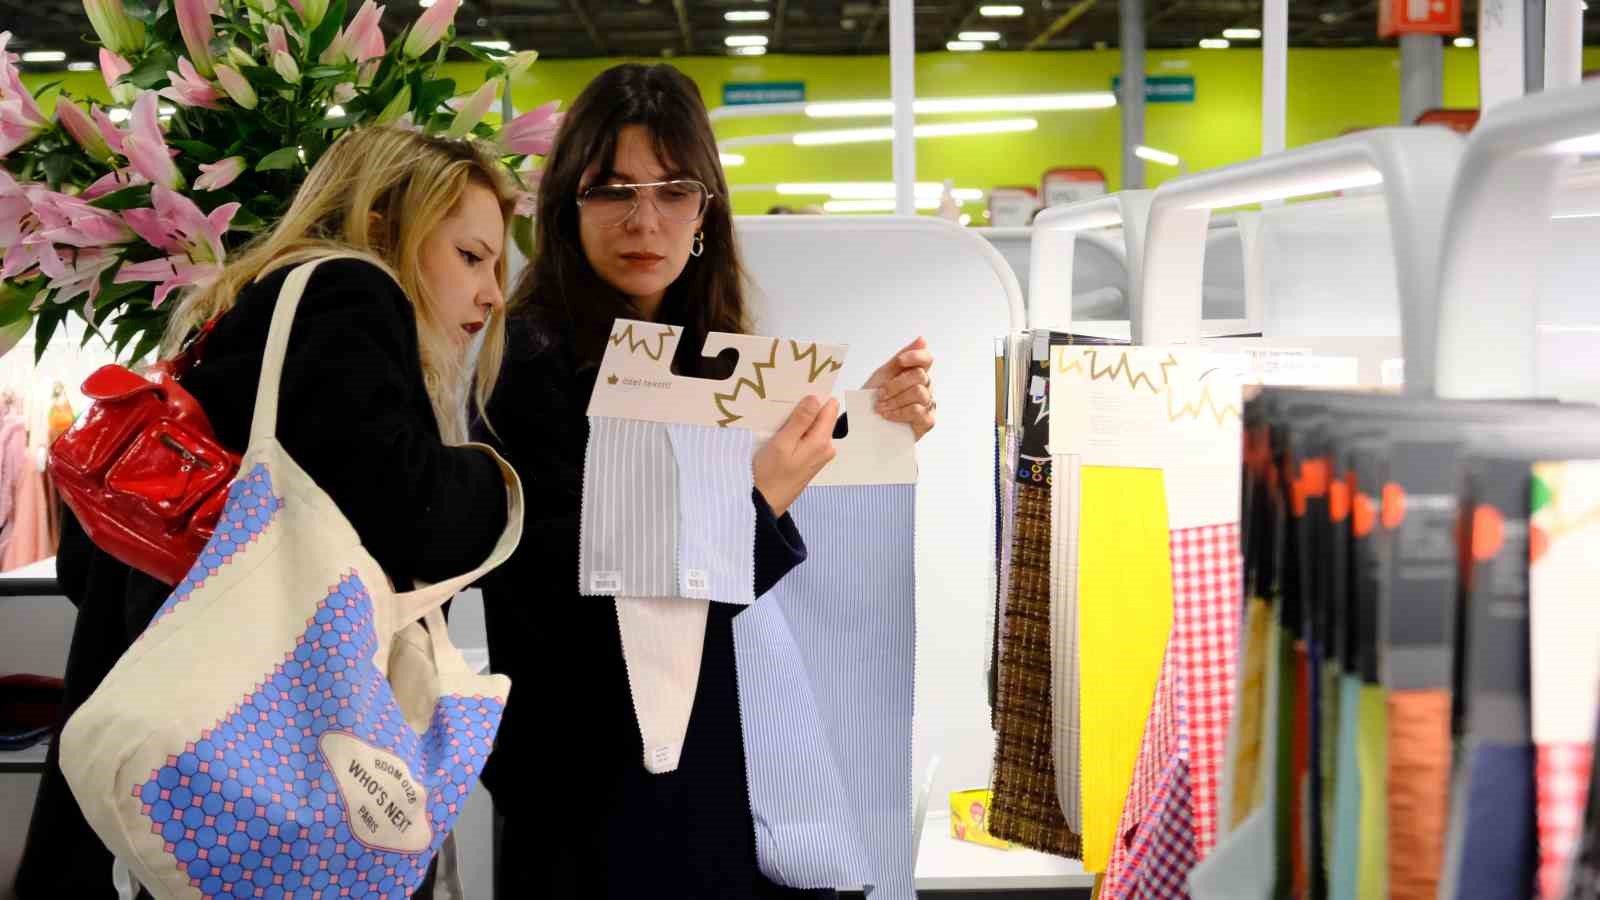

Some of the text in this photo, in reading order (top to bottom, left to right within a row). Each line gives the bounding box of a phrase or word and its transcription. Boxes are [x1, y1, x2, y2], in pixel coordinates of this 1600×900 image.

[374, 759, 403, 780] ROOM
[348, 759, 412, 833] WHO'S NEXT
[358, 805, 379, 834] PARIS
